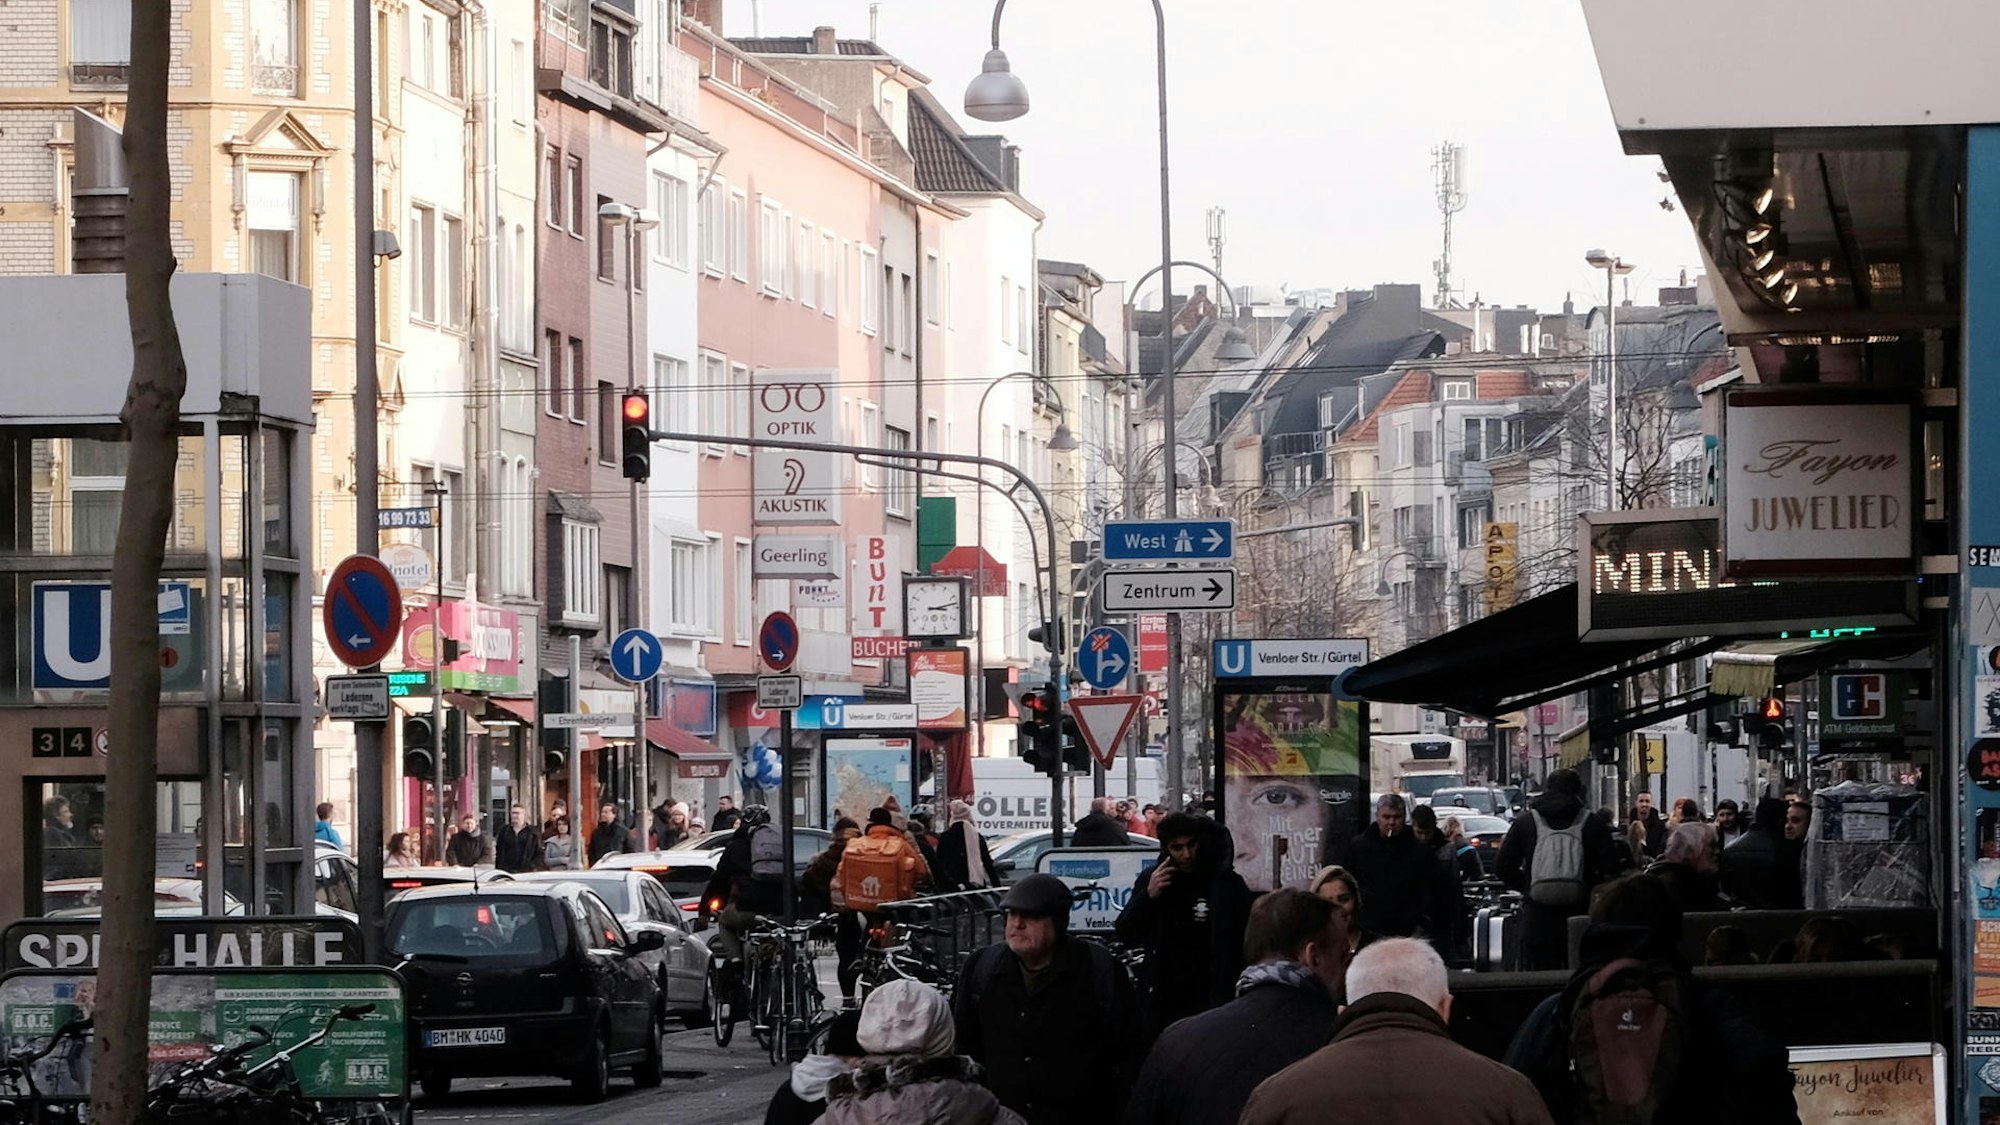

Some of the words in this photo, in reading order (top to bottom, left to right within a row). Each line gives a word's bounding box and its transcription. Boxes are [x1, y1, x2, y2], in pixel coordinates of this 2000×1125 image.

[767, 422, 816, 435] OPTIK
[1744, 439, 1899, 485] Fayon
[759, 499, 827, 513] AKUSTIK
[1745, 494, 1900, 532] JUWELIER
[391, 511, 403, 525] 99
[405, 511, 417, 525] 73
[419, 511, 430, 524] 33
[1124, 533, 1166, 549] West
[760, 548, 828, 567] Geerling
[1595, 549, 1718, 594] MIN
[1124, 583, 1196, 599] Zentrum
[44, 591, 111, 681] U
[1221, 645, 1245, 674] U
[1259, 652, 1299, 664] Venloer
[1301, 651, 1320, 663] Str.
[1328, 651, 1362, 663] Gürtel
[558, 715, 617, 726] Ehrenfeldgürtel
[39, 734, 54, 752] 3
[69, 733, 85, 752] 4
[1320, 788, 1352, 802] Simple
[977, 820, 1067, 830] TOVERMIETU
[1269, 815, 1296, 833] Mit
[1262, 826, 1324, 845] miner
[433, 1031, 448, 1045] BM
[457, 1030, 471, 1043] HK
[474, 1029, 504, 1042] 4040
[1845, 1060, 1926, 1093] Juwelier
